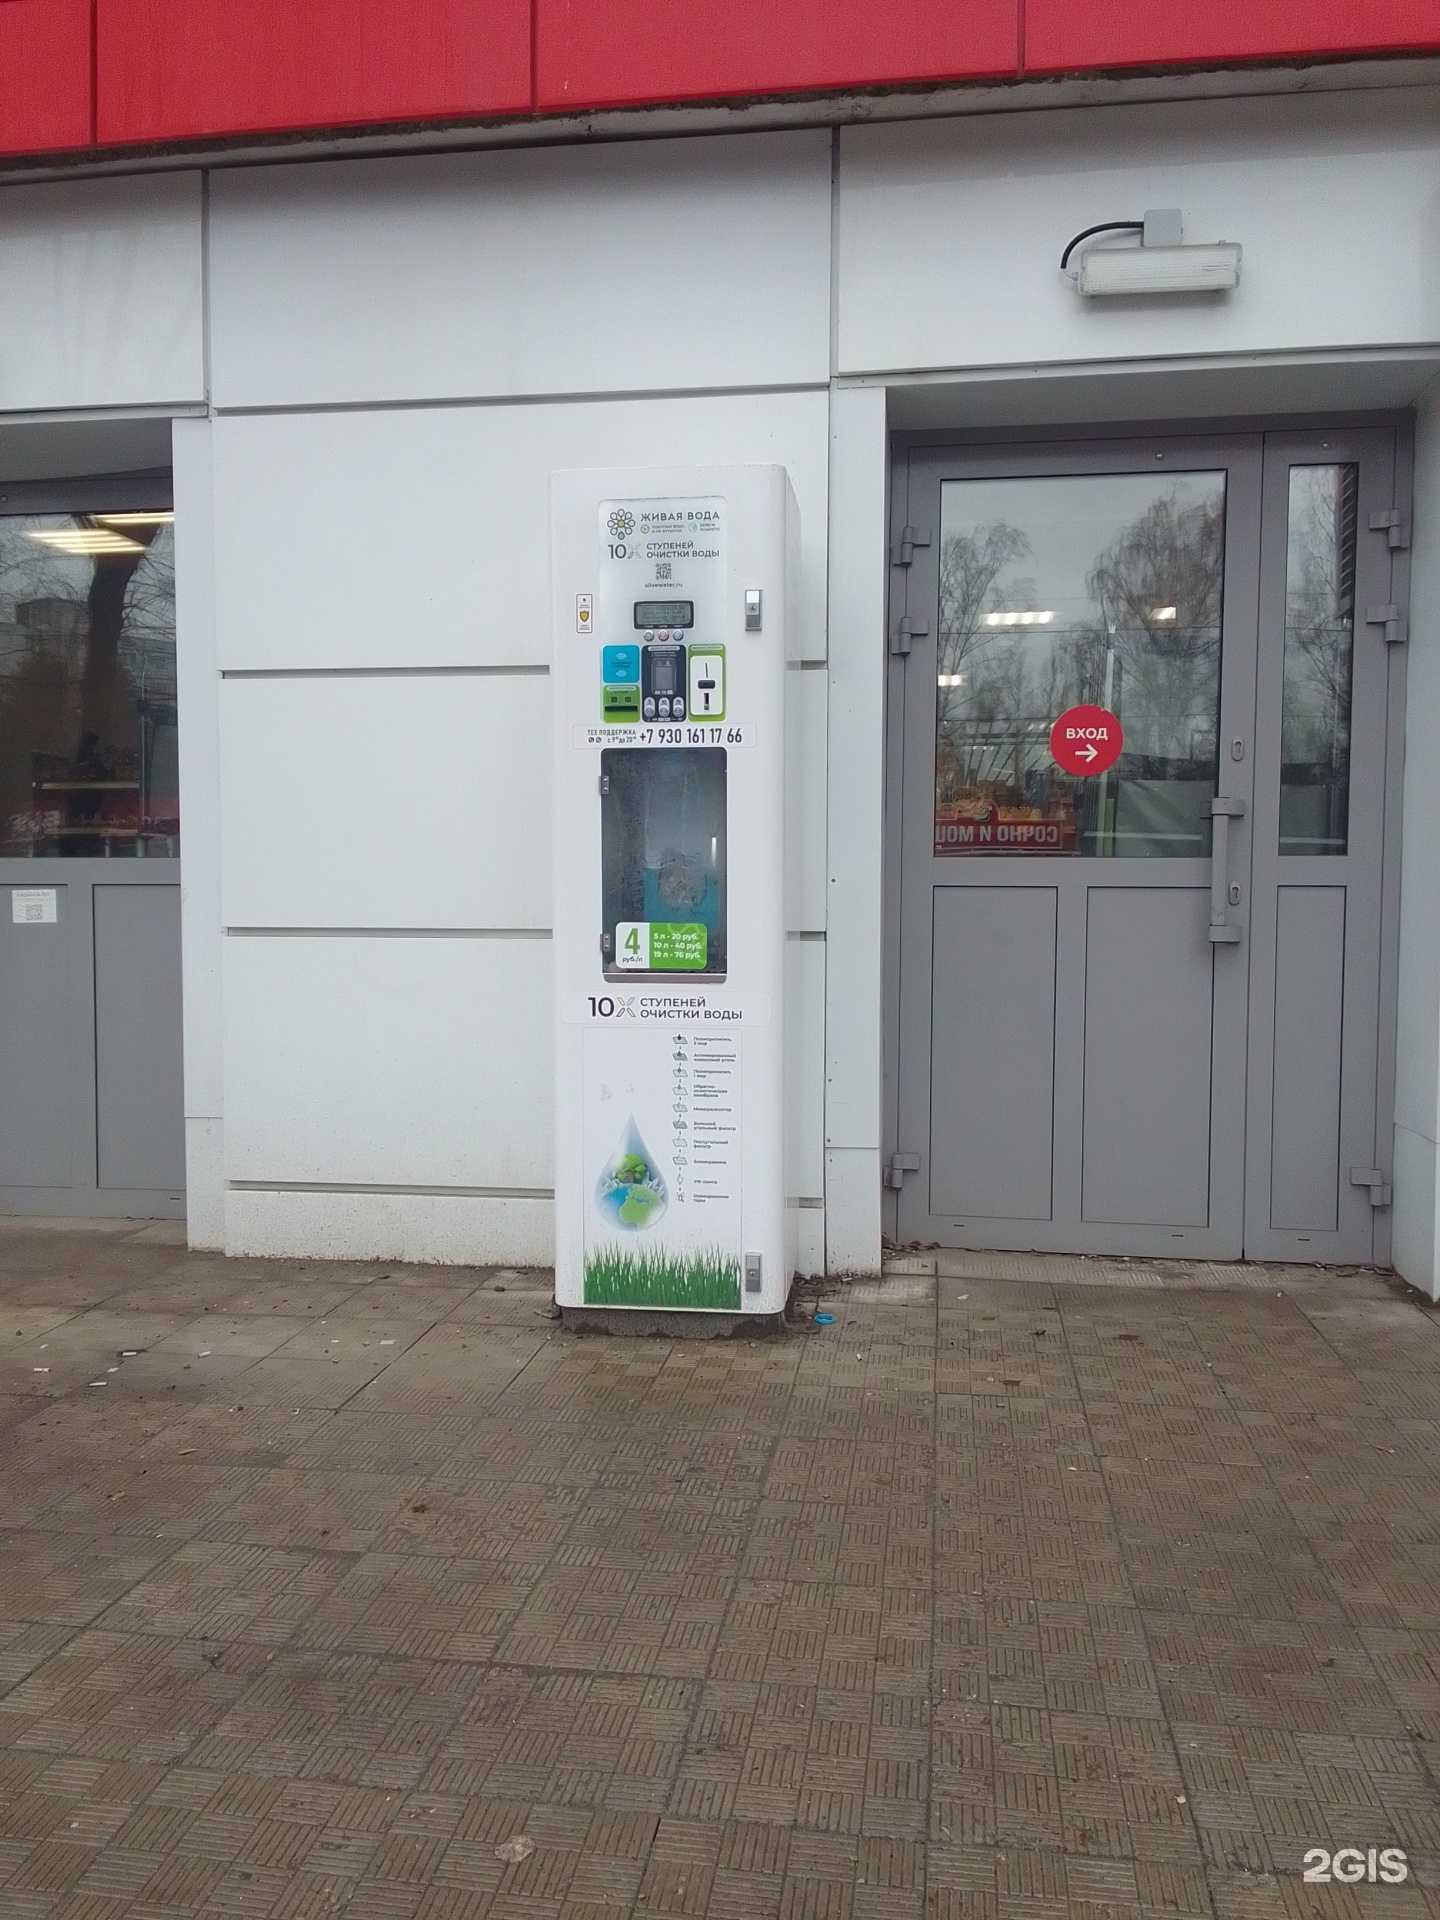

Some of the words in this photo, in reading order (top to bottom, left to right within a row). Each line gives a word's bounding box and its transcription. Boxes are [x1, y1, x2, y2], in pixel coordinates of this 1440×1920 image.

[640, 512, 683, 522] ЖИВАЯ
[687, 511, 720, 521] ВОДА
[646, 541, 694, 550] СТУПЕНЕЙ
[646, 551, 689, 559] ОЧИСТКИ
[692, 550, 720, 558] ВОДЫ
[640, 729, 654, 744] +7
[658, 729, 682, 744] 930
[687, 729, 705, 743] 161
[709, 728, 722, 743] 17
[727, 728, 742, 743] 66
[1066, 728, 1108, 739] ВХОД
[624, 928, 640, 954] 4
[683, 933, 699, 942] руб.
[687, 942, 702, 951] руб.
[685, 951, 701, 960] руб.
[640, 997, 706, 1007] СТУПЕНЕЙ
[640, 1009, 700, 1019] ОЧИСТКИ
[704, 1009, 742, 1019] ВОДЫ
